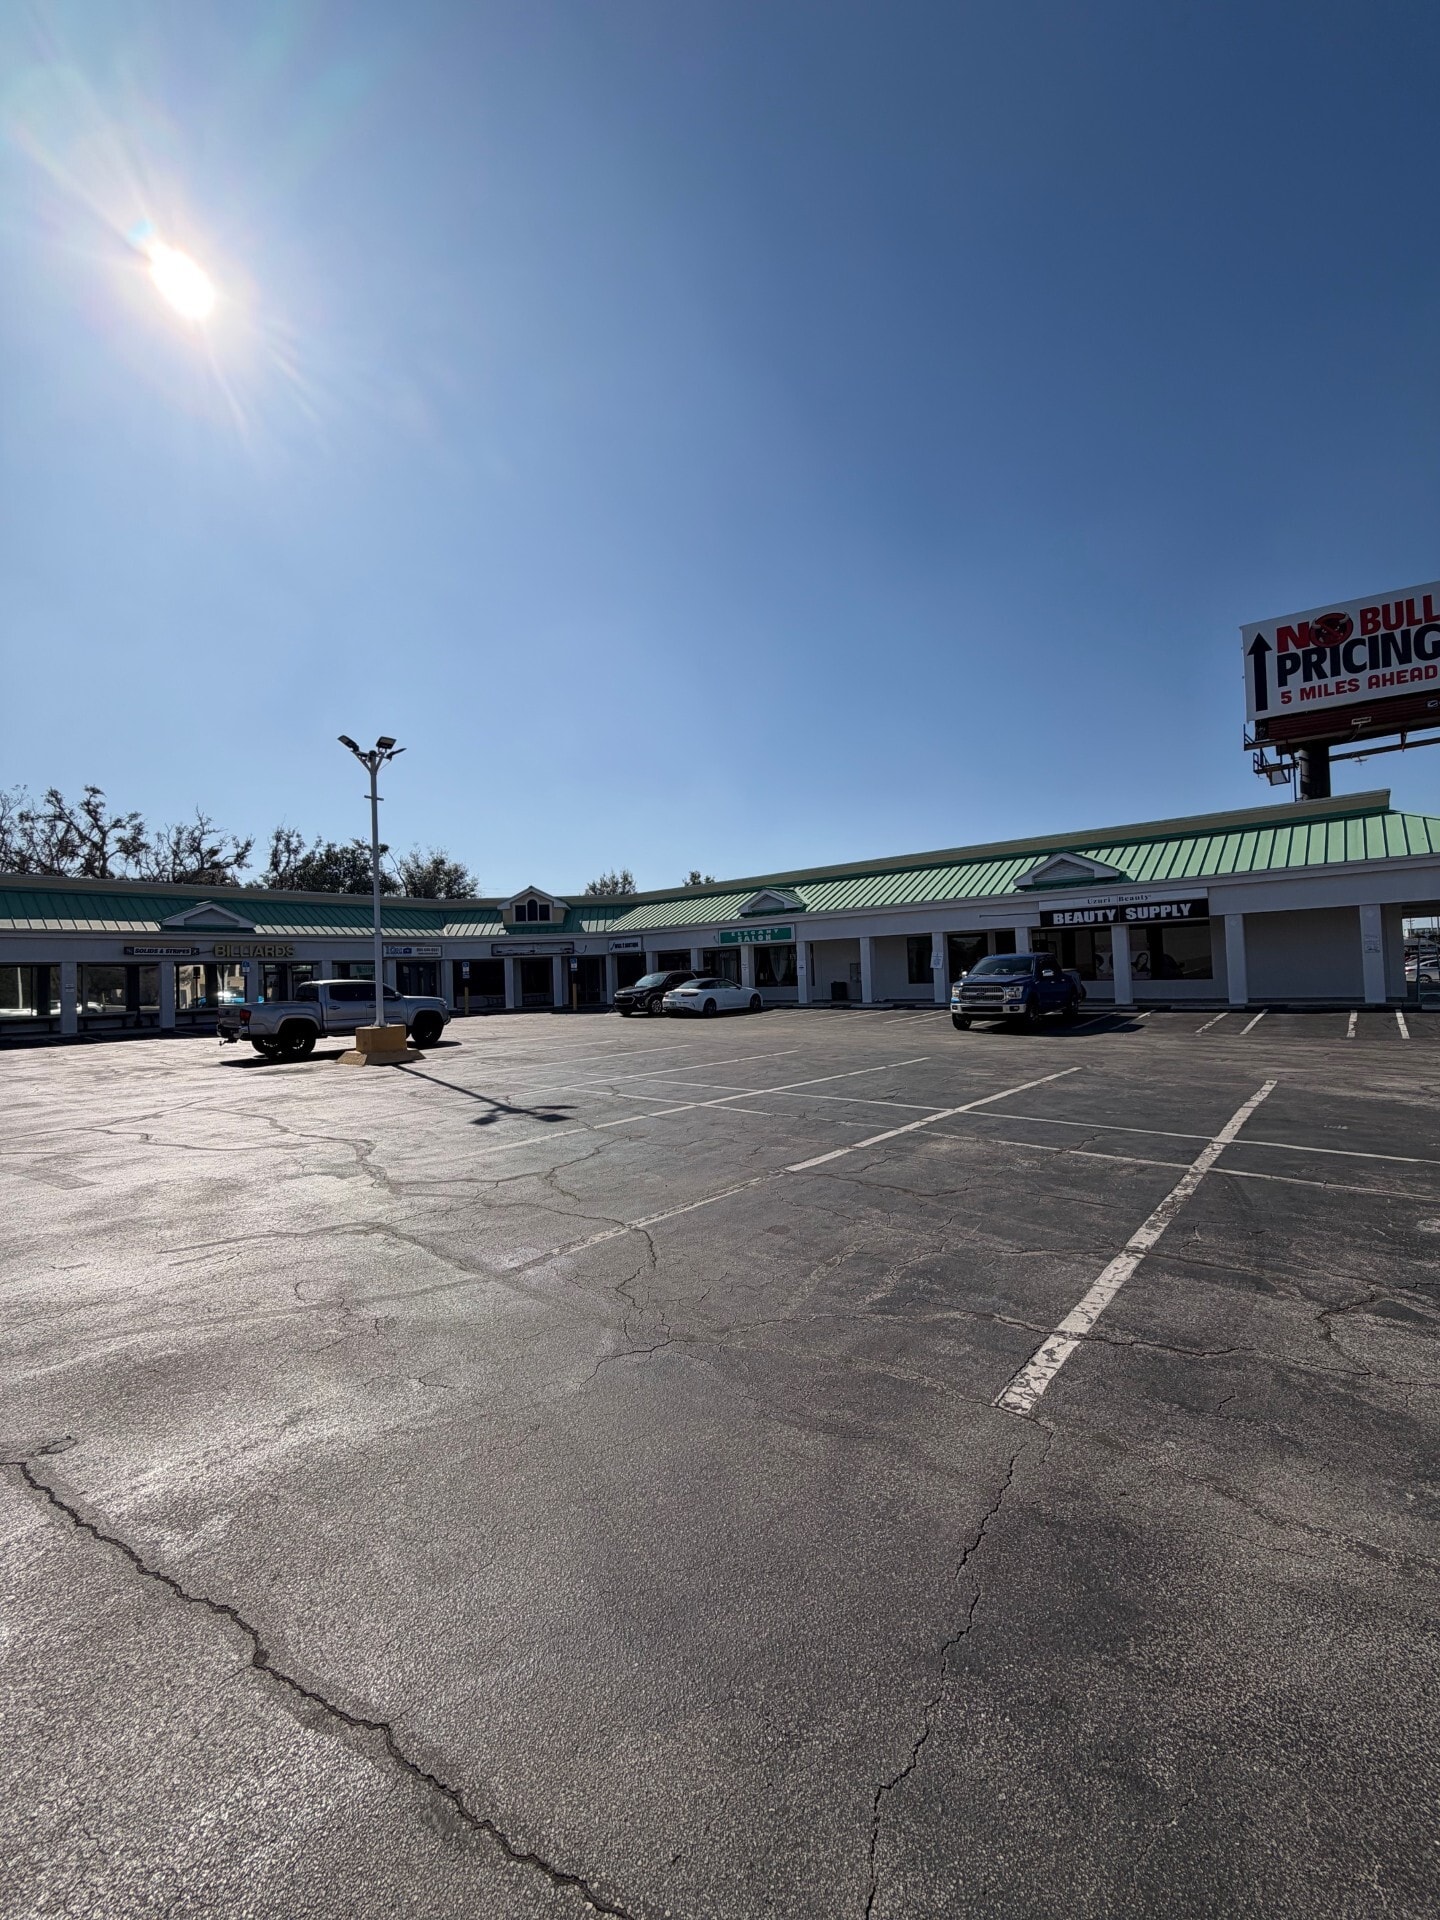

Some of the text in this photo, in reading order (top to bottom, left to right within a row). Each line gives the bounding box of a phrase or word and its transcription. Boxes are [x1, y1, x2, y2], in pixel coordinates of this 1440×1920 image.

[1276, 595, 1440, 653] NO BULL
[1277, 623, 1440, 688] PRICING
[1280, 664, 1438, 705] 5 MILES AHEAD
[1118, 894, 1149, 903] Beauty
[1053, 904, 1191, 924] BEAUTY SUPPLY
[214, 944, 295, 958] BILLIARDS
